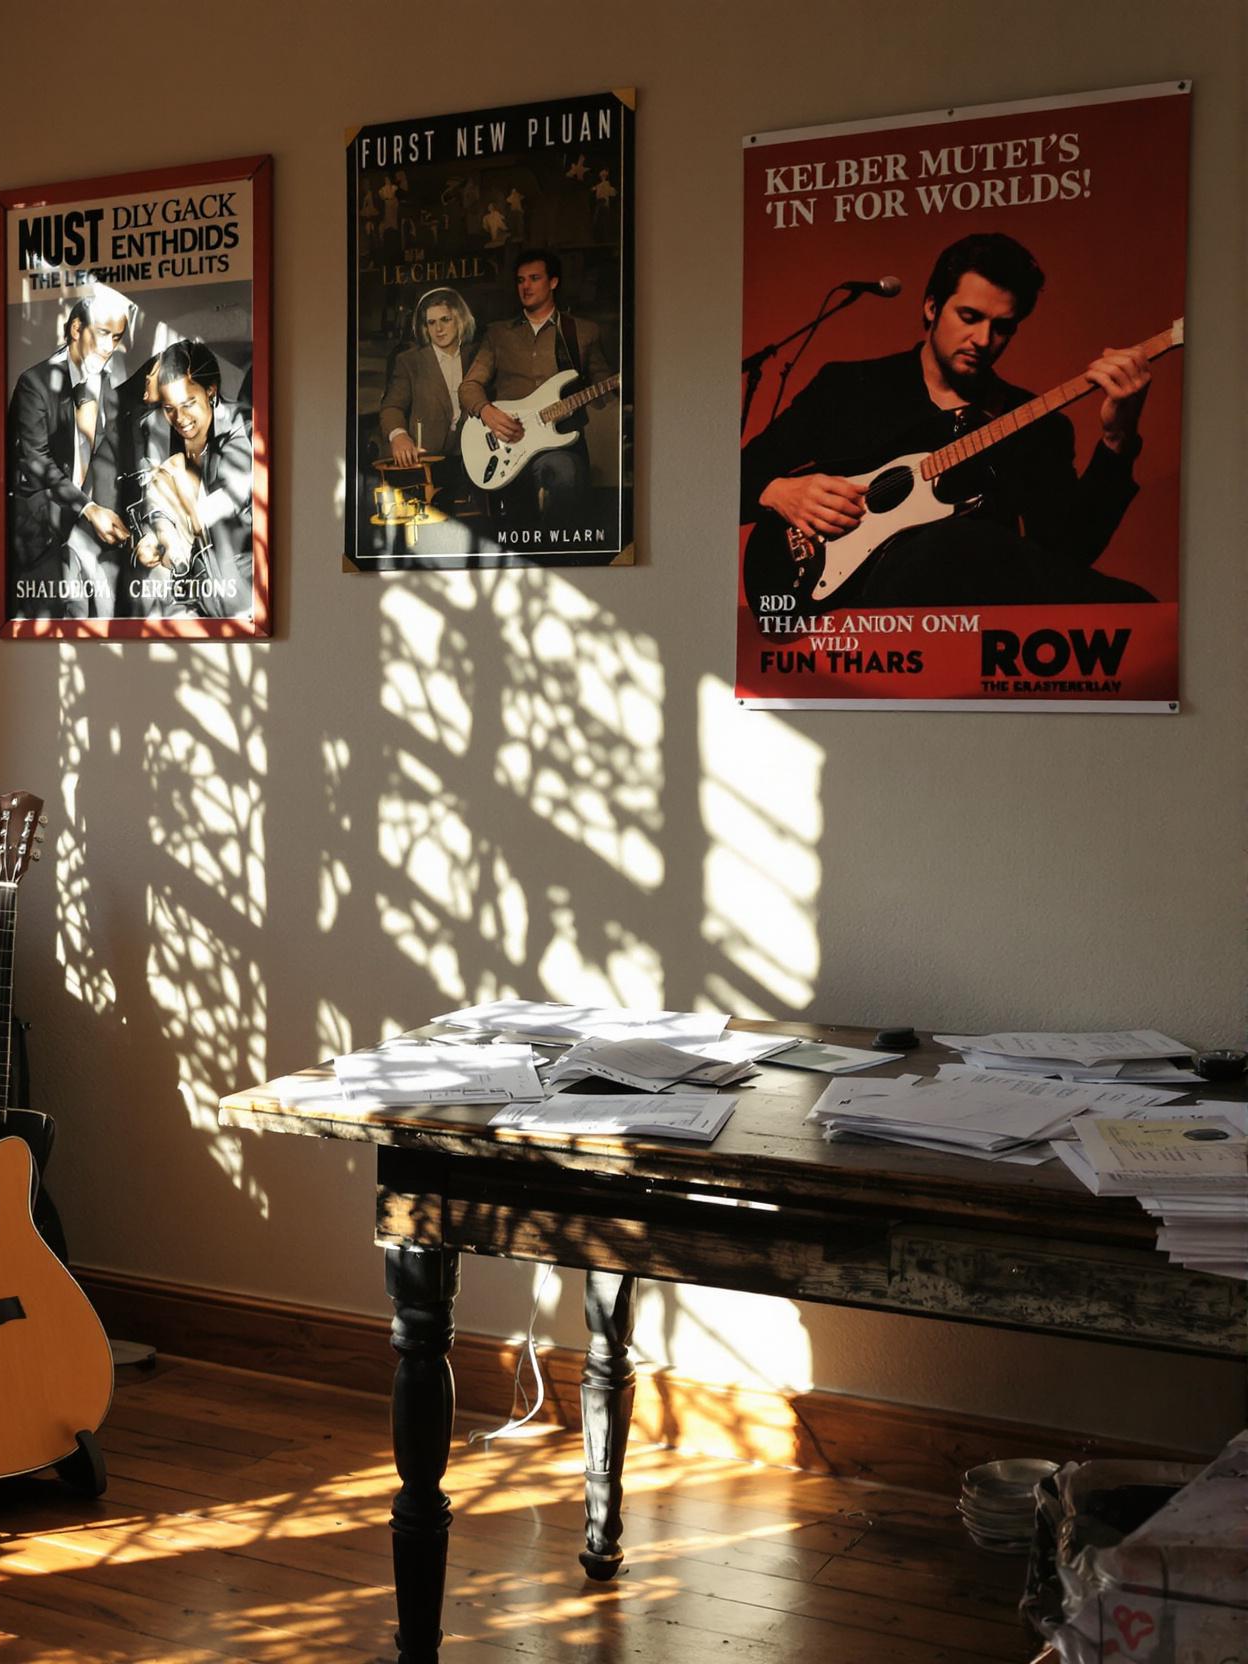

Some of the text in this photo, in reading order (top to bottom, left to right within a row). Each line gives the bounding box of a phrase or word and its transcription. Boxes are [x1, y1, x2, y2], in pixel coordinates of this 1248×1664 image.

[456, 121, 506, 158] NEW
[527, 108, 611, 148] PLUAN
[764, 153, 910, 196] KELBER
[833, 187, 908, 223] FOR
[917, 169, 1092, 216] WORLDS!
[161, 192, 236, 224] GACK
[18, 208, 104, 271] MUST
[760, 615, 836, 634] THALE
[809, 636, 859, 651] WILD
[760, 650, 924, 674] FUN THARS
[980, 629, 1132, 678] ROW
